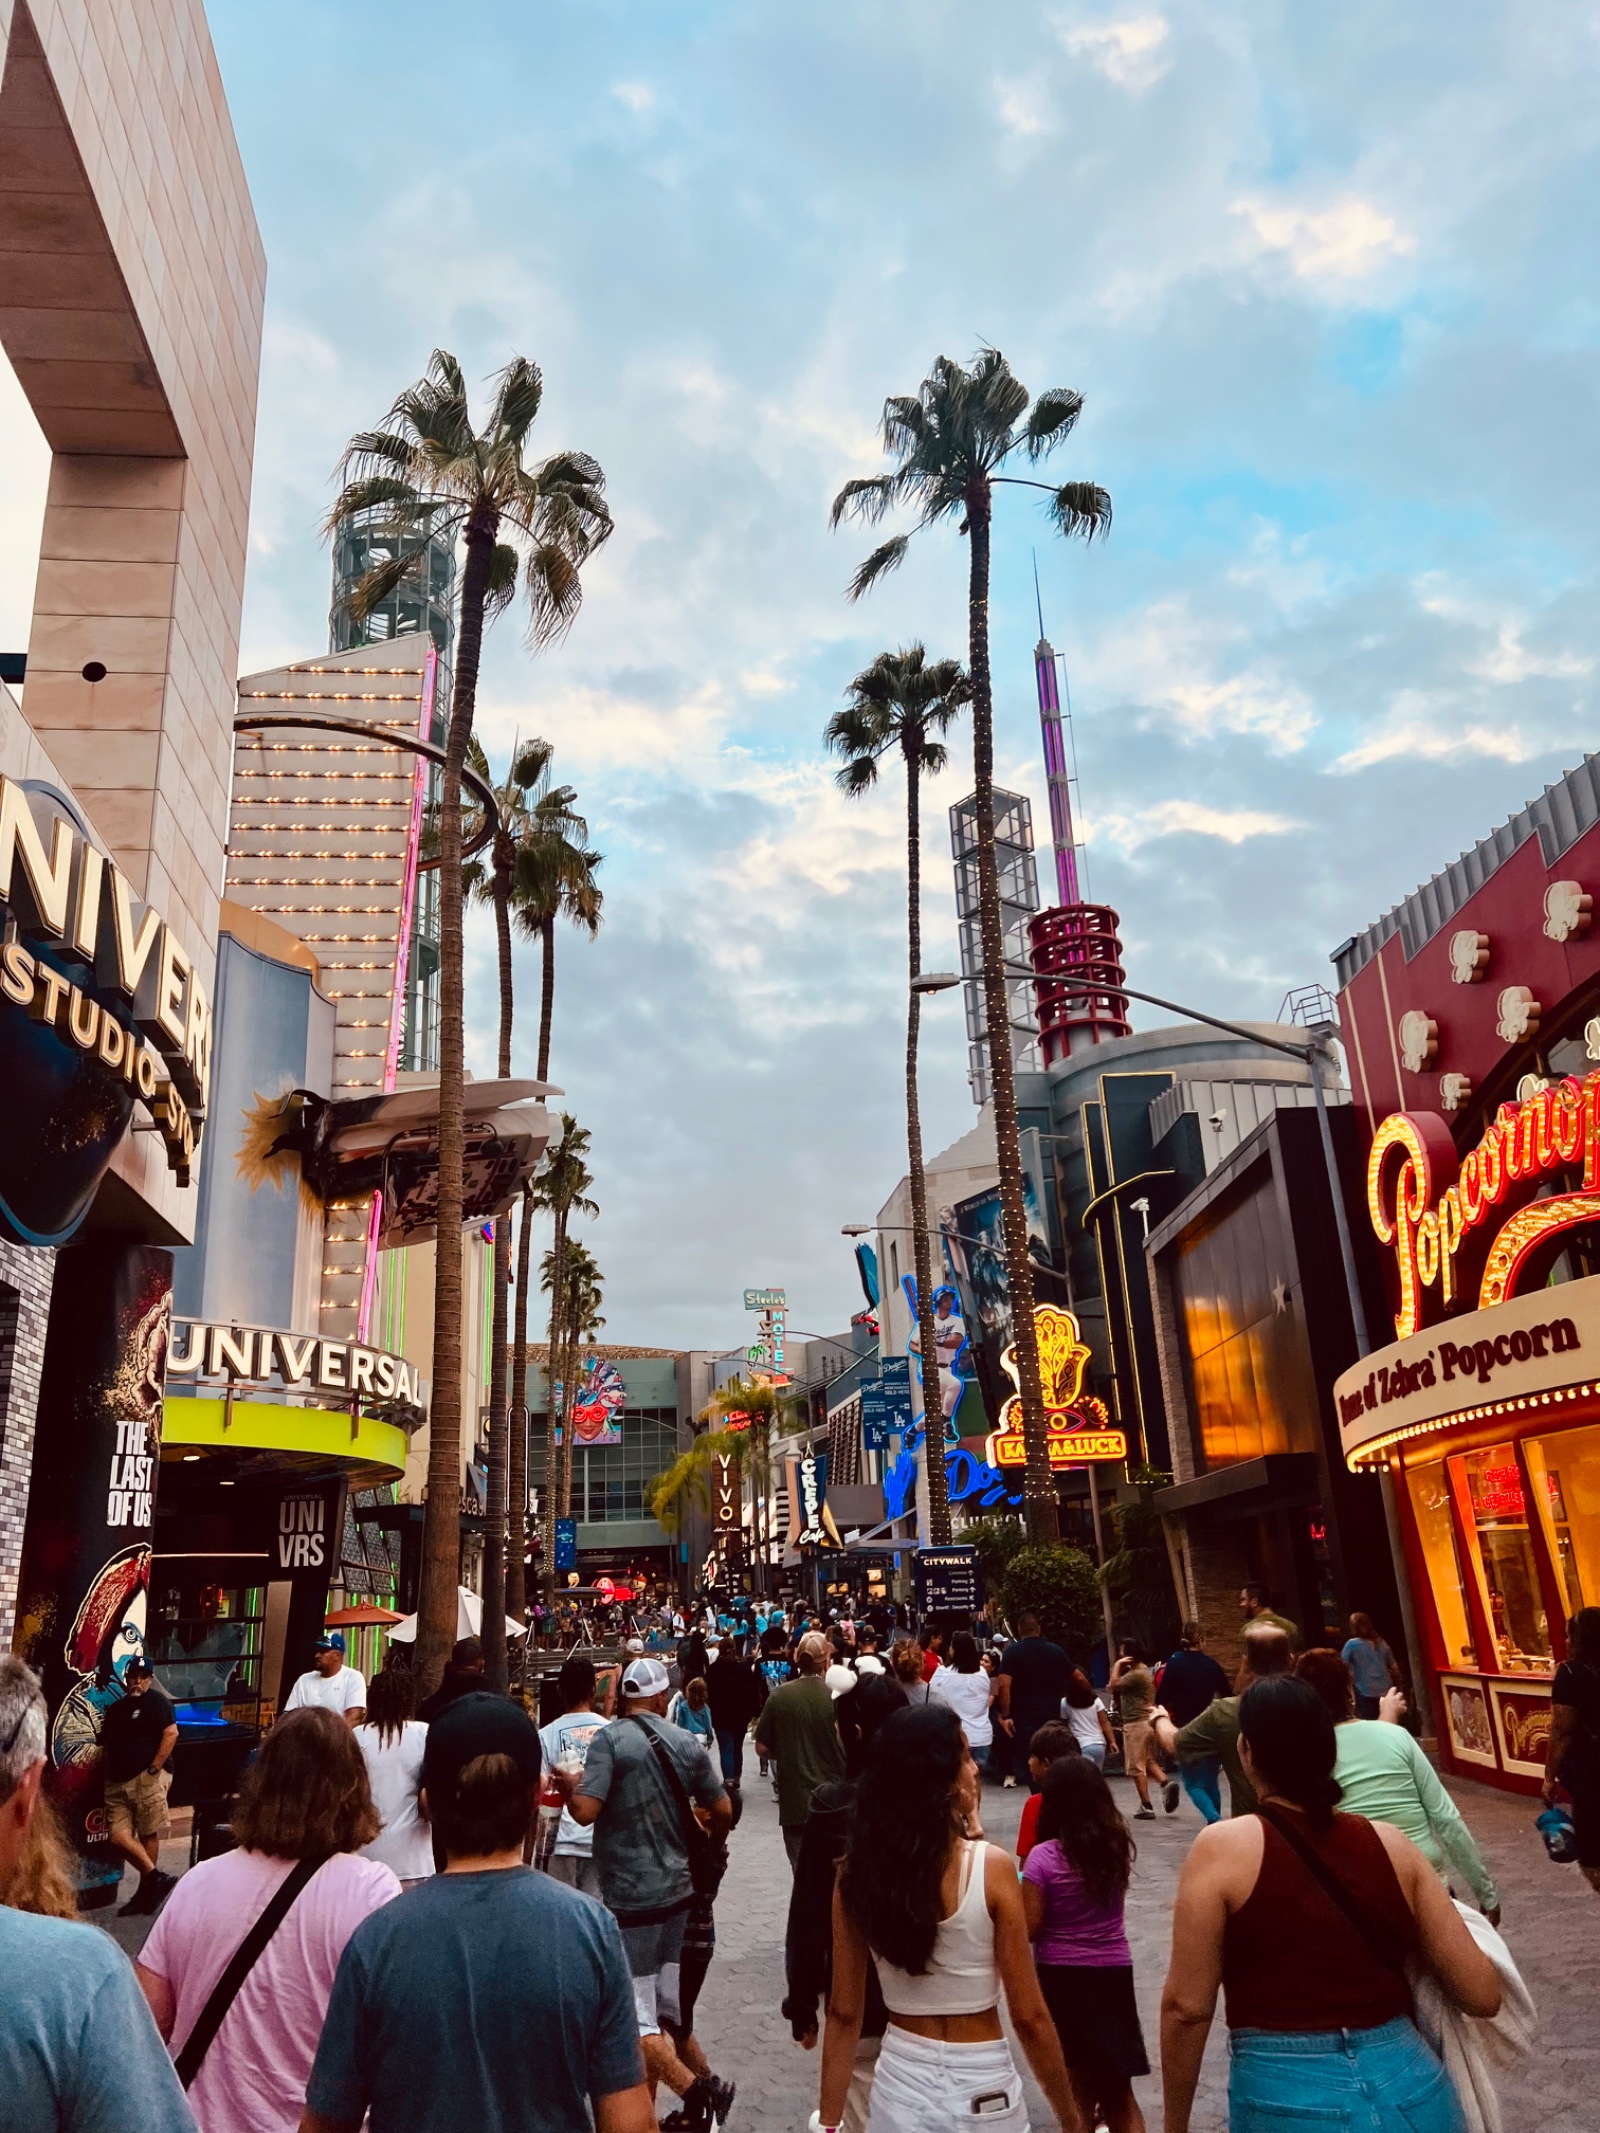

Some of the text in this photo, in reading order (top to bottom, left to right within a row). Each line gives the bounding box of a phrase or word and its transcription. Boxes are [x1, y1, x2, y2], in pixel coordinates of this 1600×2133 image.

[746, 1292, 785, 1305] Steele's
[771, 1311, 785, 1376] MOTEL
[1437, 1317, 1581, 1384] Popcorn
[165, 1324, 423, 1408] UNIVERSAL
[893, 1411, 906, 1428] LA
[116, 1420, 149, 1456] THE
[1003, 1437, 1122, 1458] KAA&LUCK
[109, 1455, 154, 1492] LAST
[718, 1453, 734, 1521] VIVO
[106, 1491, 153, 1527] OF US
[801, 1458, 820, 1529] CREPE
[279, 1500, 325, 1533] UNI
[278, 1533, 325, 1567] VRS
[799, 1528, 826, 1544] Cafe
[923, 1557, 972, 1566] CITYWALK
